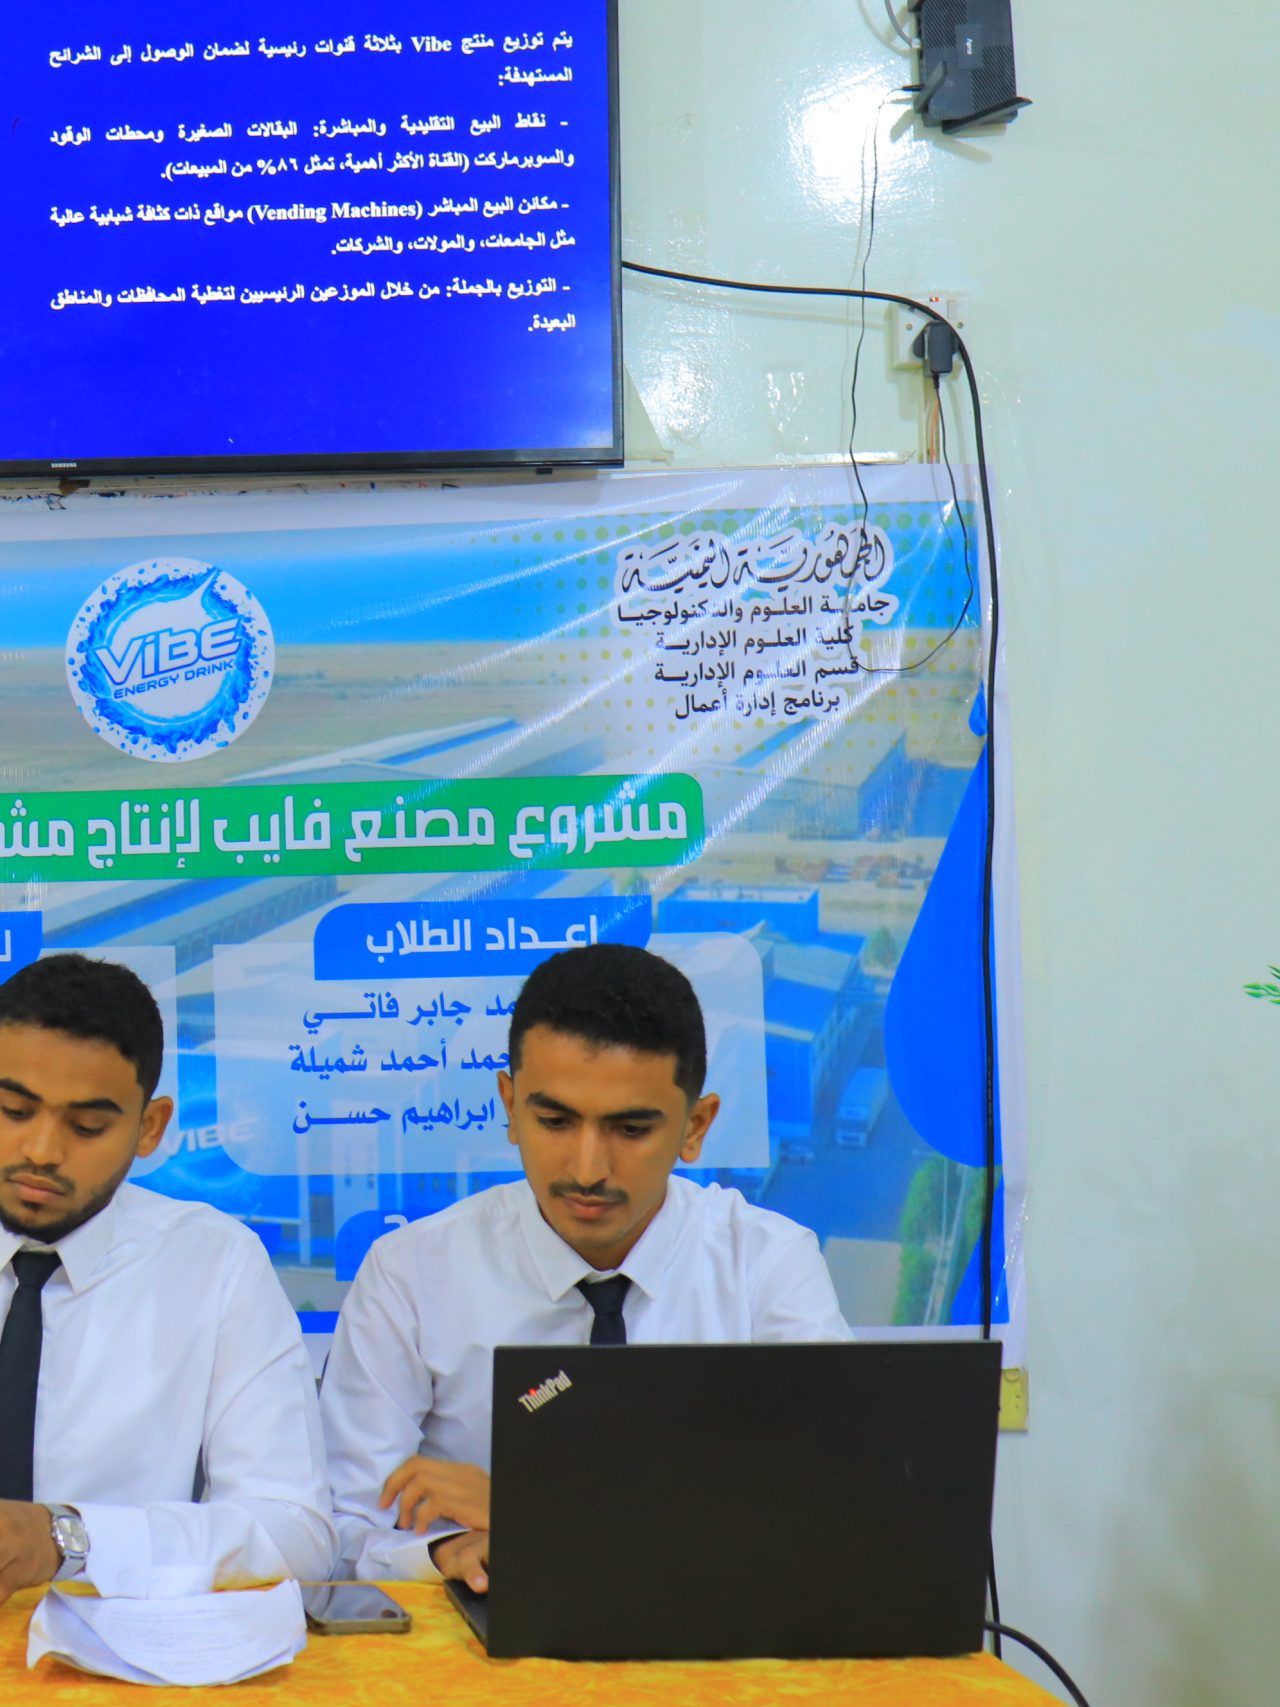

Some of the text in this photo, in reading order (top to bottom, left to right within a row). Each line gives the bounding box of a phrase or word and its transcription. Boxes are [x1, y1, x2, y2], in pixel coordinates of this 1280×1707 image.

[48, 30, 574, 69] يتم توزيع منتج Vibe بثلاثة قنوات رئيسية لضمان الوصول إلى الشرائح
[246, 119, 298, 140] البقالات
[399, 114, 456, 136] التقليدية
[469, 113, 502, 137] البيع
[514, 111, 547, 129] نقاط
[49, 125, 92, 147] الوقود
[105, 124, 165, 144] ومحطات
[177, 122, 233, 143] الصغيرة
[230, 161, 253, 178] من
[303, 154, 336, 175] تمثل
[386, 150, 425, 174] الأكثر
[473, 148, 575, 170] والسوبرماركت
[88, 205, 134, 227] شبابية
[135, 203, 172, 222] كثافة
[173, 202, 201, 221] ذات
[203, 202, 244, 227] مواقع
[427, 196, 479, 218] المباشر
[482, 195, 515, 219] البيع
[517, 195, 558, 215] مكائن
[49, 206, 86, 228] عالية
[549, 228, 577, 250] مثل
[49, 288, 113, 311] والمناطق
[116, 285, 187, 304] المحافظات
[190, 283, 236, 306] لتغطية
[239, 283, 306, 305] الرئيسيين
[310, 281, 376, 303] الموزعين
[380, 280, 415, 301] خلال
[418, 283, 441, 300] من
[506, 276, 557, 301] التوزيع
[751, 595, 813, 624] العلوم
[820, 594, 890, 616] جامة
[655, 625, 854, 656] كلية العلوم الإدارية
[113, 659, 234, 700] ENERGY DRINK
[654, 661, 735, 688] الإدارية
[814, 656, 859, 683] قسم
[675, 688, 728, 719] أعمال
[783, 689, 841, 715] برنامج
[213, 795, 331, 864] فايب
[345, 796, 495, 862] مصنع
[509, 781, 688, 859] مشروع
[87, 797, 200, 869] لإنتاج
[366, 918, 472, 963] الطلاب
[406, 992, 471, 1026] جابر
[287, 1043, 368, 1080] شميلة
[381, 1038, 448, 1071] أحمد
[292, 1097, 495, 1134] ابراهيم حسن
[518, 1369, 573, 1413] ThinkPad
